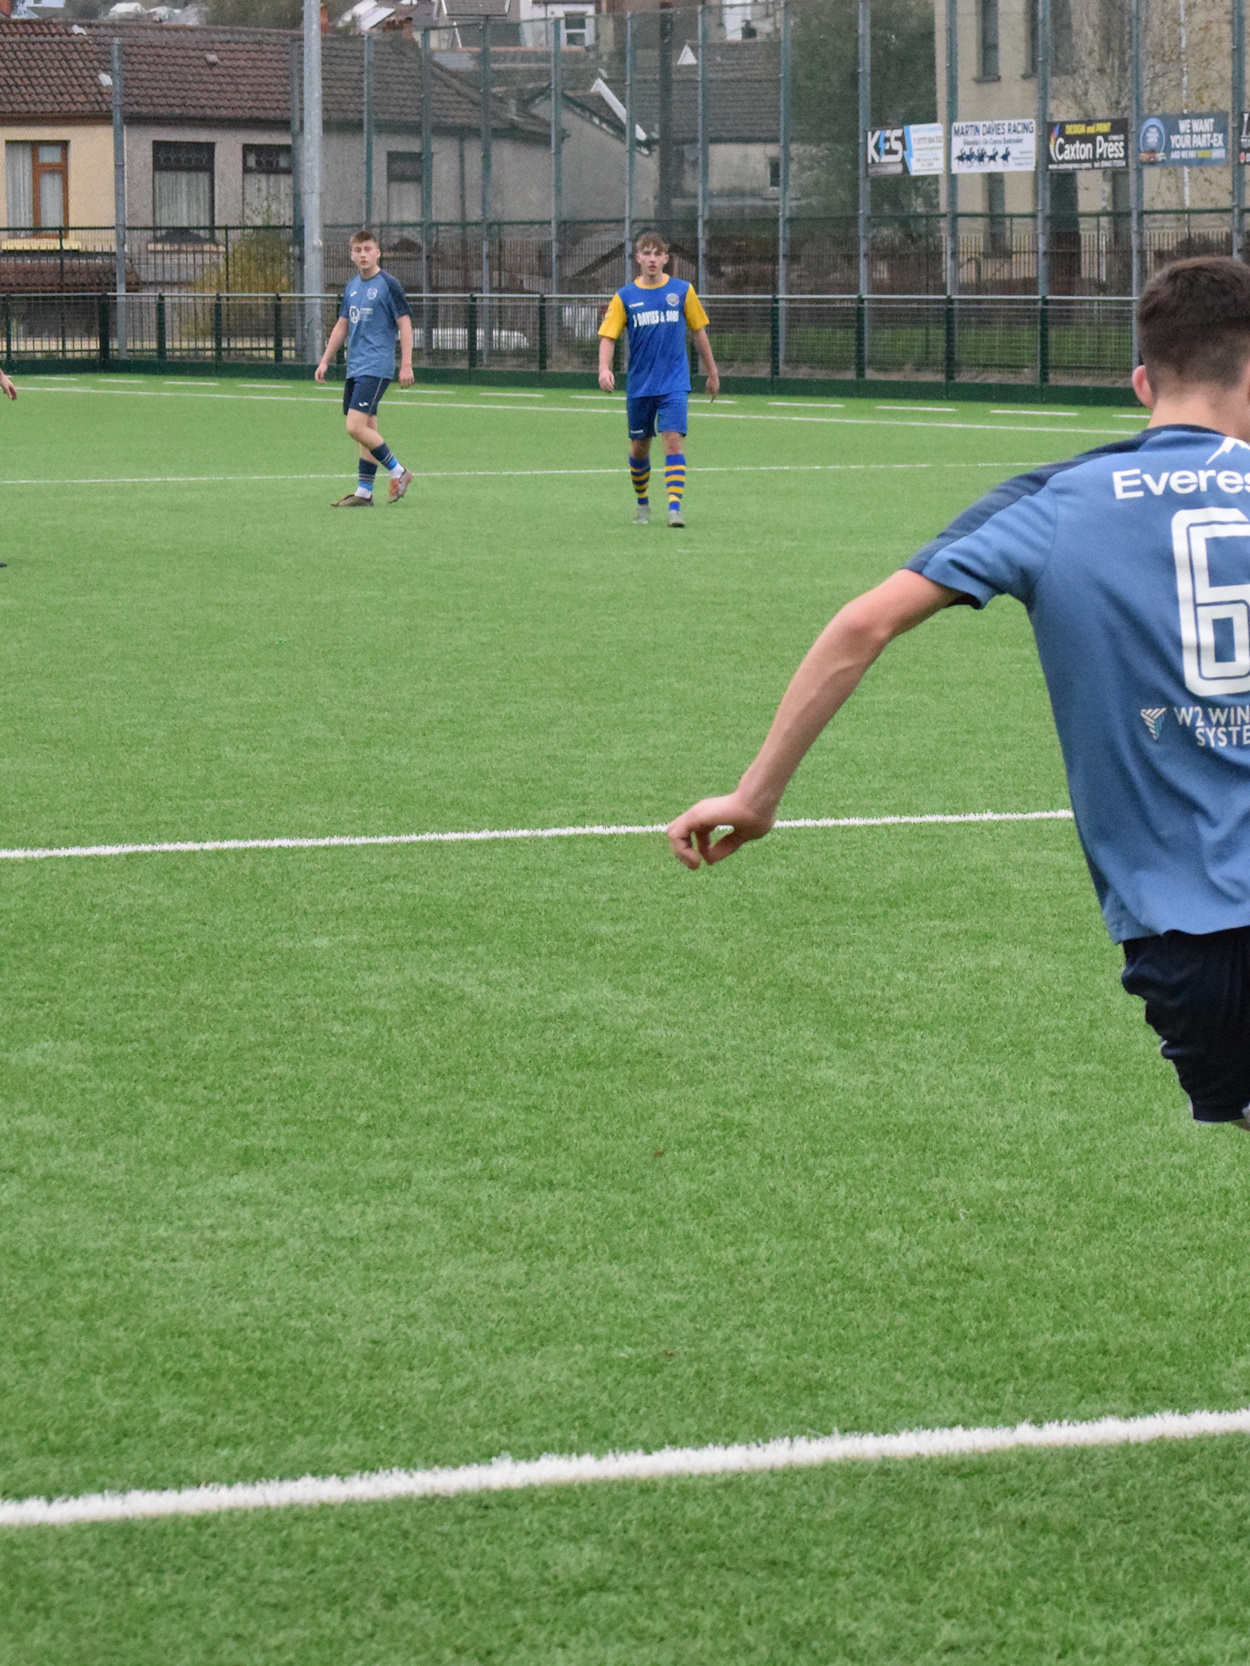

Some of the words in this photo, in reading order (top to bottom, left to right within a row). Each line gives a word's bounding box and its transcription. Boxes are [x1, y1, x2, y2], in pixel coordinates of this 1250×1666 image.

[953, 124, 980, 137] MARTIN
[982, 122, 1006, 136] DAVIES
[1007, 121, 1034, 134] RACING
[1179, 119, 1191, 133] WE
[1192, 118, 1214, 132] WANT
[1055, 137, 1093, 160] Caxton
[1096, 135, 1125, 159] Press
[1170, 134, 1191, 148] YOUR
[1173, 705, 1206, 728] W2
